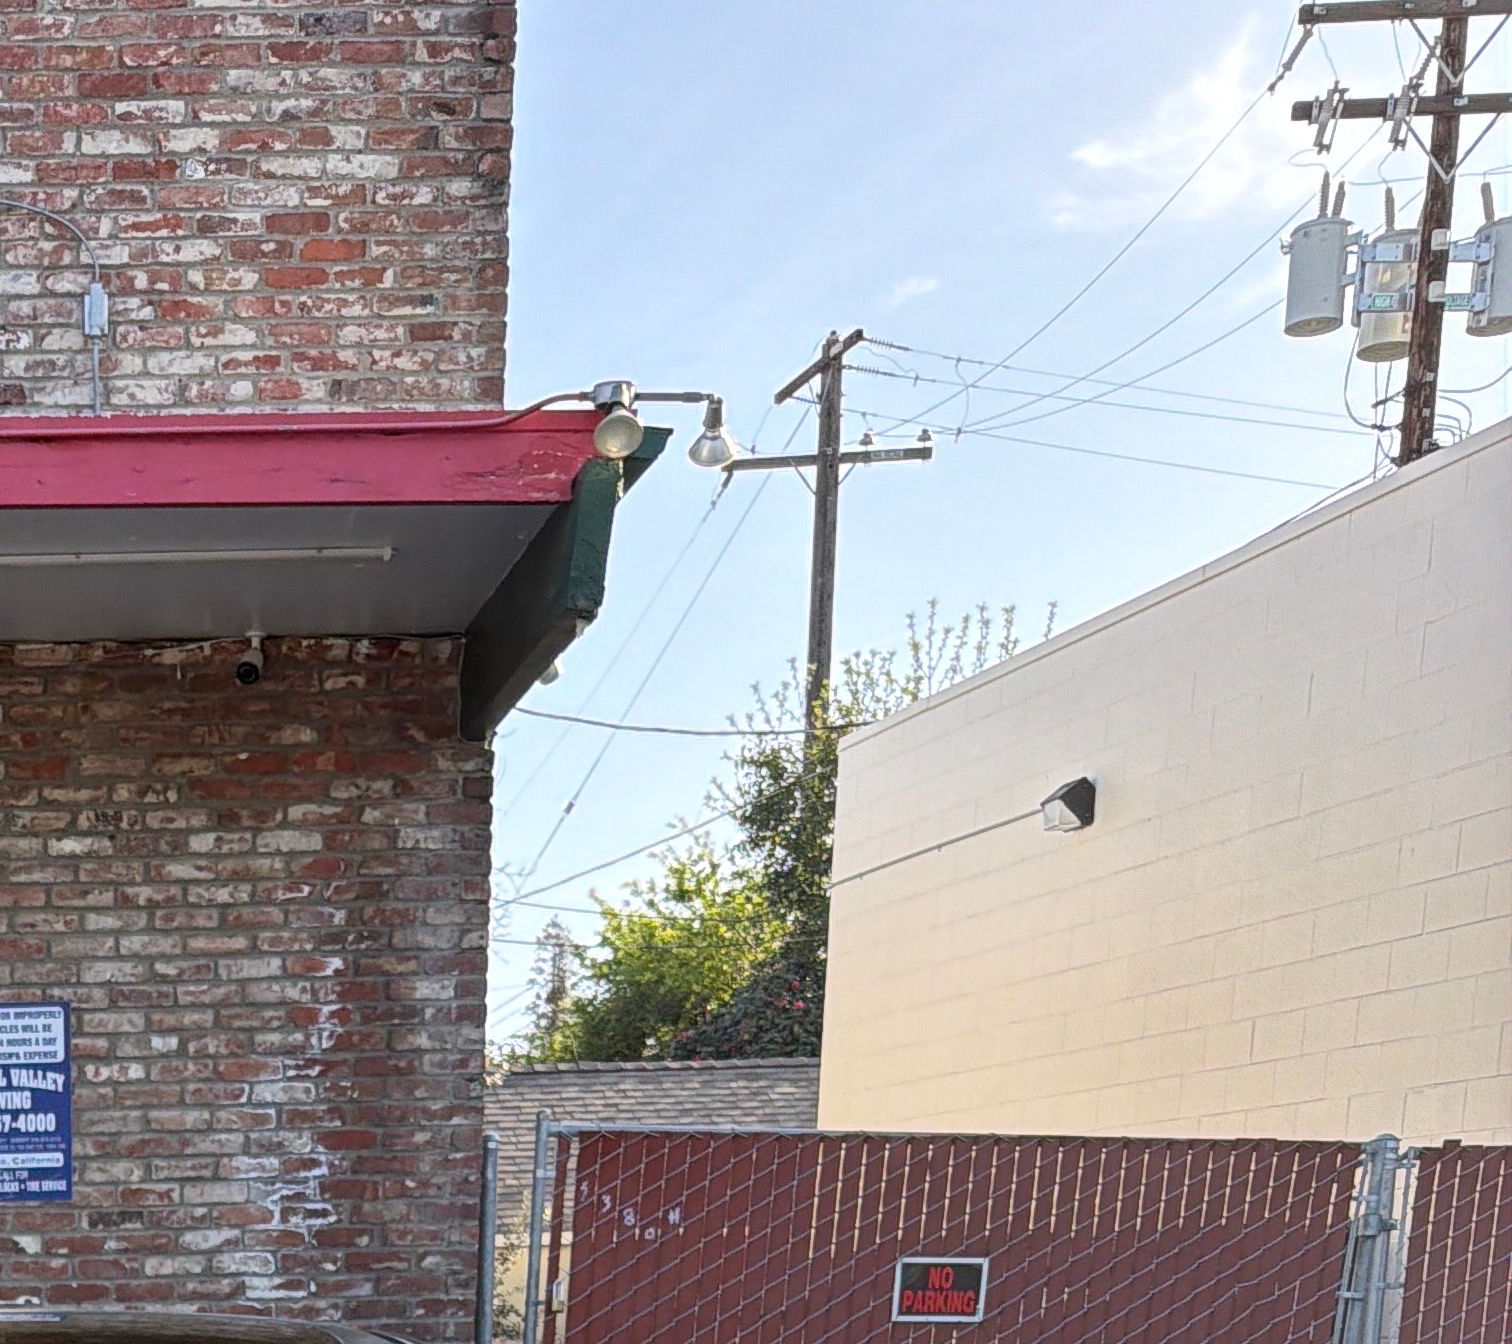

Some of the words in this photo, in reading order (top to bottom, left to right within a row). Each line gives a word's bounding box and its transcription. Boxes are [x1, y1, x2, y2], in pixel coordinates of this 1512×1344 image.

[21, 1024, 41, 1034] WILL
[41, 1023, 53, 1033] BE
[6, 1038, 33, 1048] HOURS
[42, 1036, 58, 1047] DAY
[23, 1050, 59, 1060] EXPENSE
[9, 1068, 66, 1093] VALLEY
[11, 1155, 62, 1166] California
[928, 1266, 955, 1290] NO
[901, 1289, 976, 1314] PARKING
